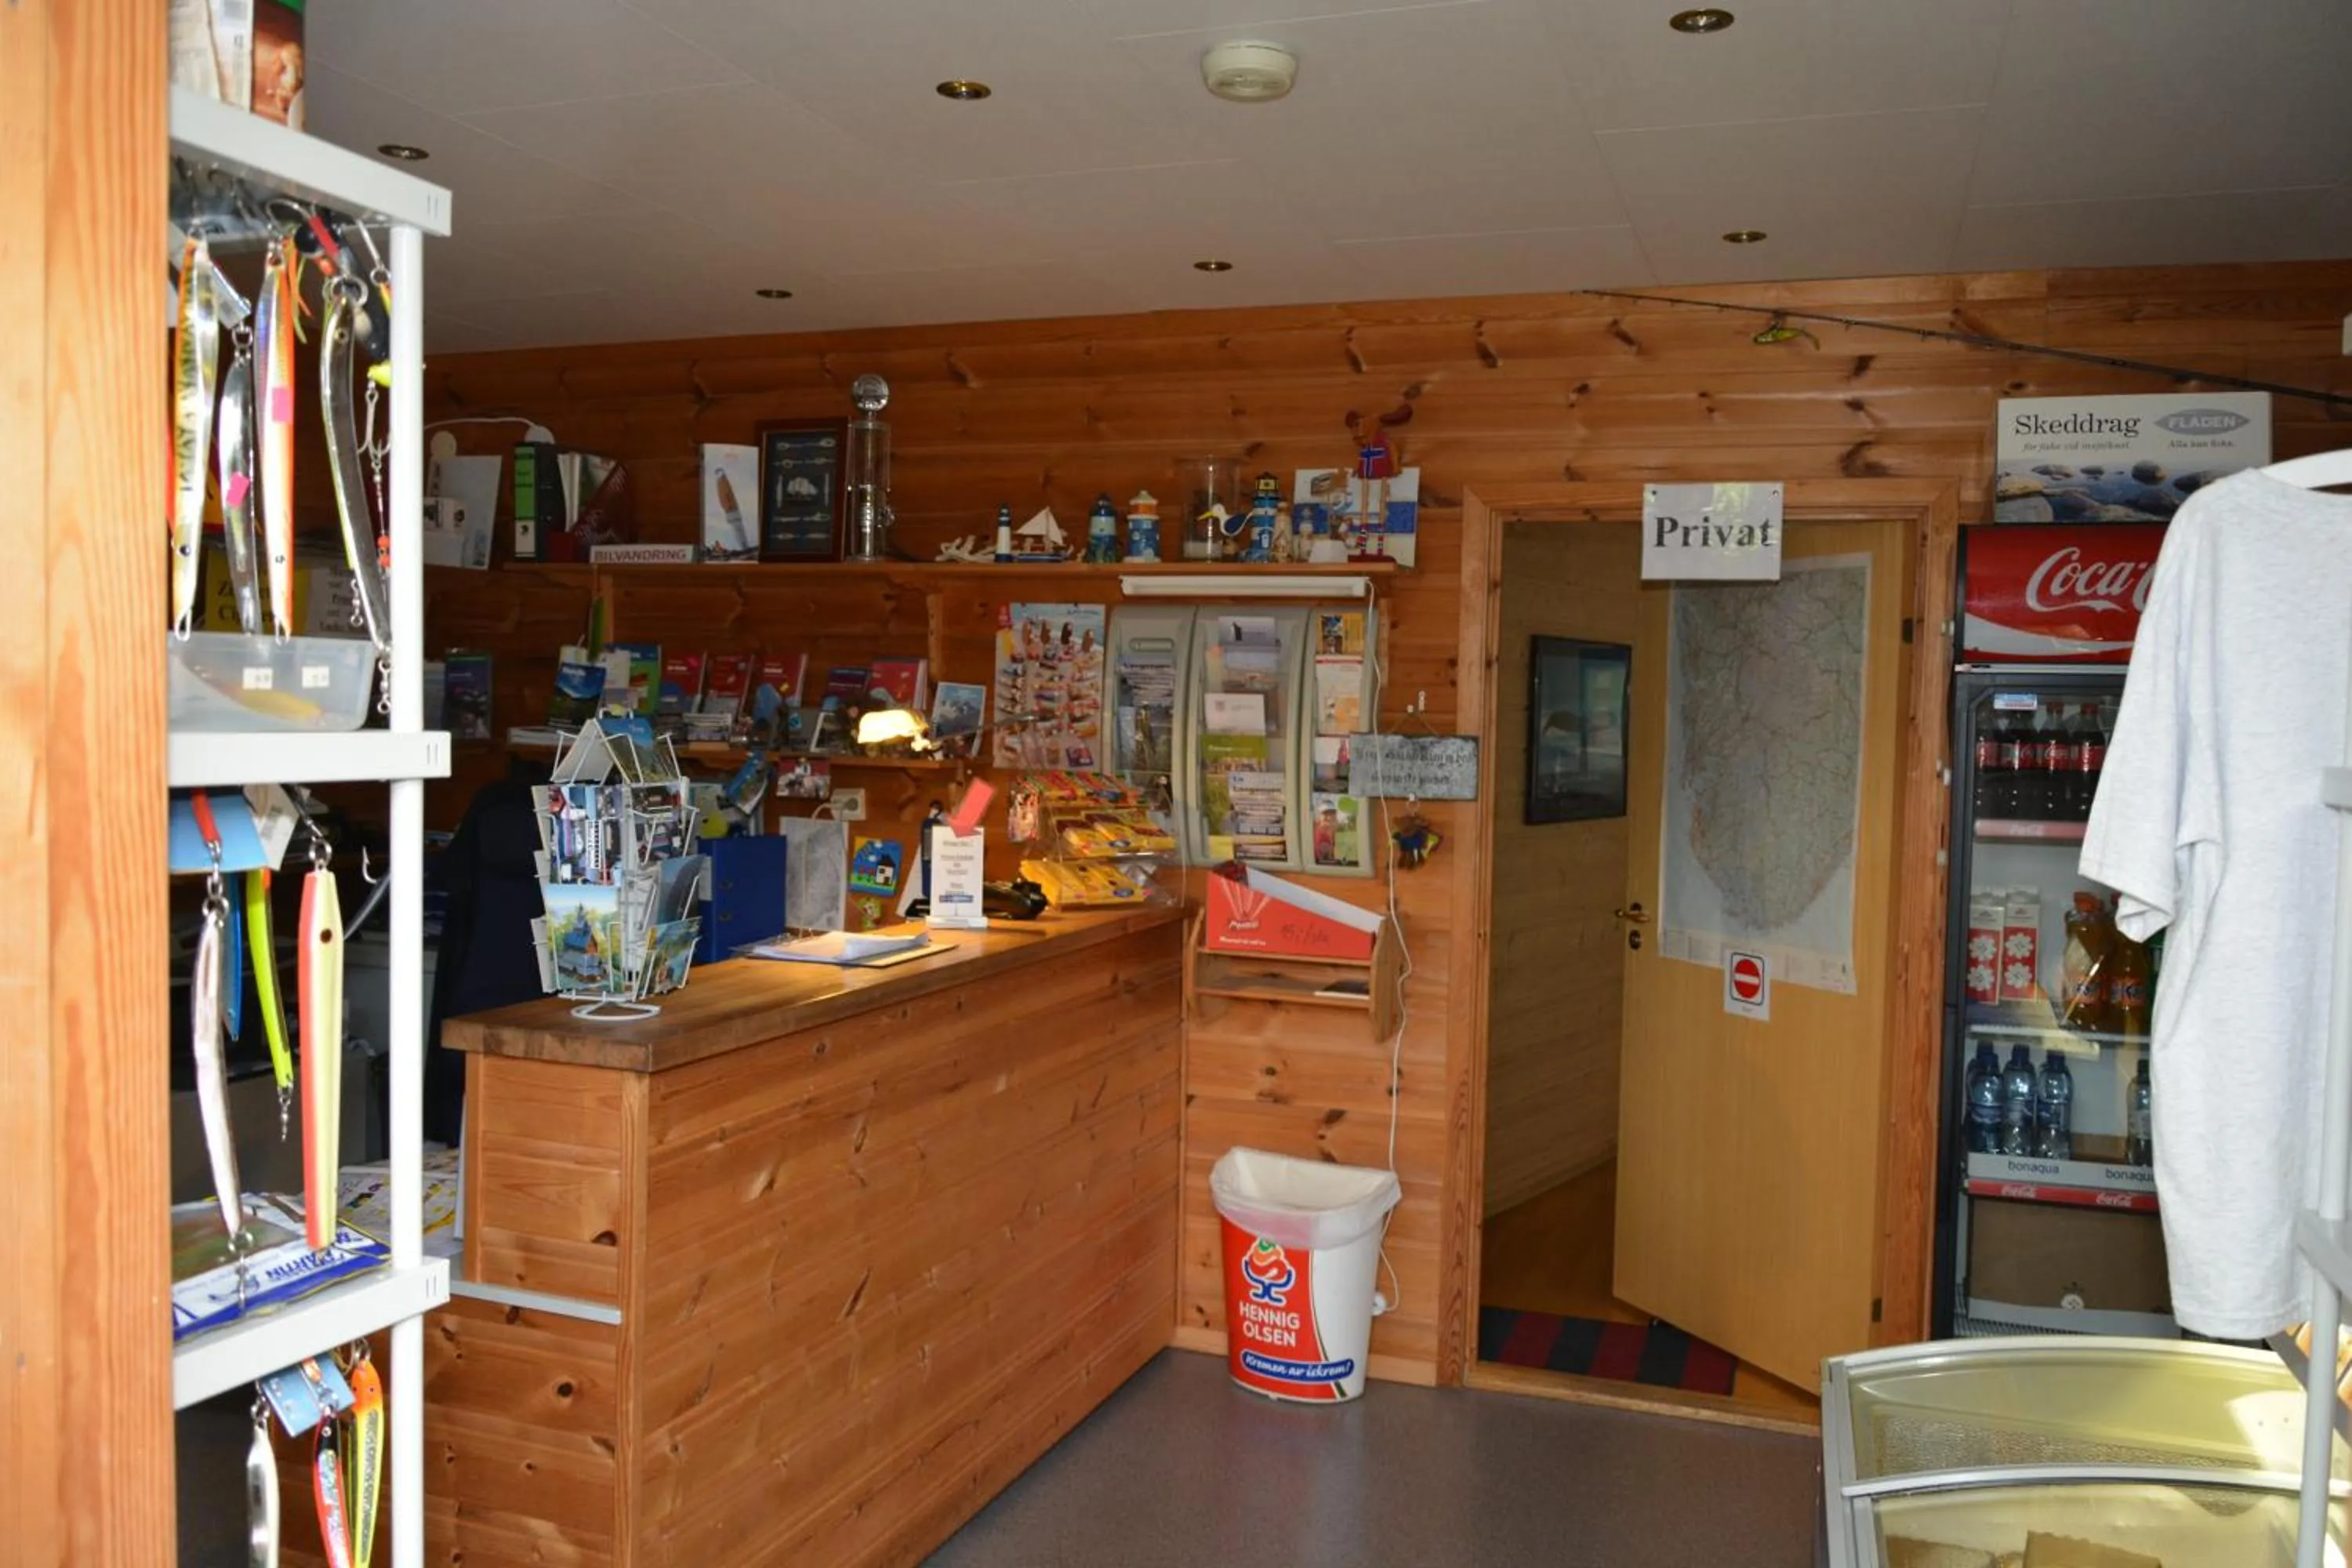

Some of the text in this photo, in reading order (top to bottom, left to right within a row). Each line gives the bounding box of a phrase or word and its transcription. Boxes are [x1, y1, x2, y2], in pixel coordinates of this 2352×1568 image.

[2014, 412, 2140, 437] Skeddrag
[2167, 415, 2237, 429] FLADEN
[1653, 516, 1777, 548] Privat
[2008, 1160, 2154, 1182] bonaqua bonaqu
[1239, 1302, 1301, 1330] HENNIG
[1243, 1323, 1296, 1348] OLSEN
[1245, 1354, 1287, 1377] Kremen
